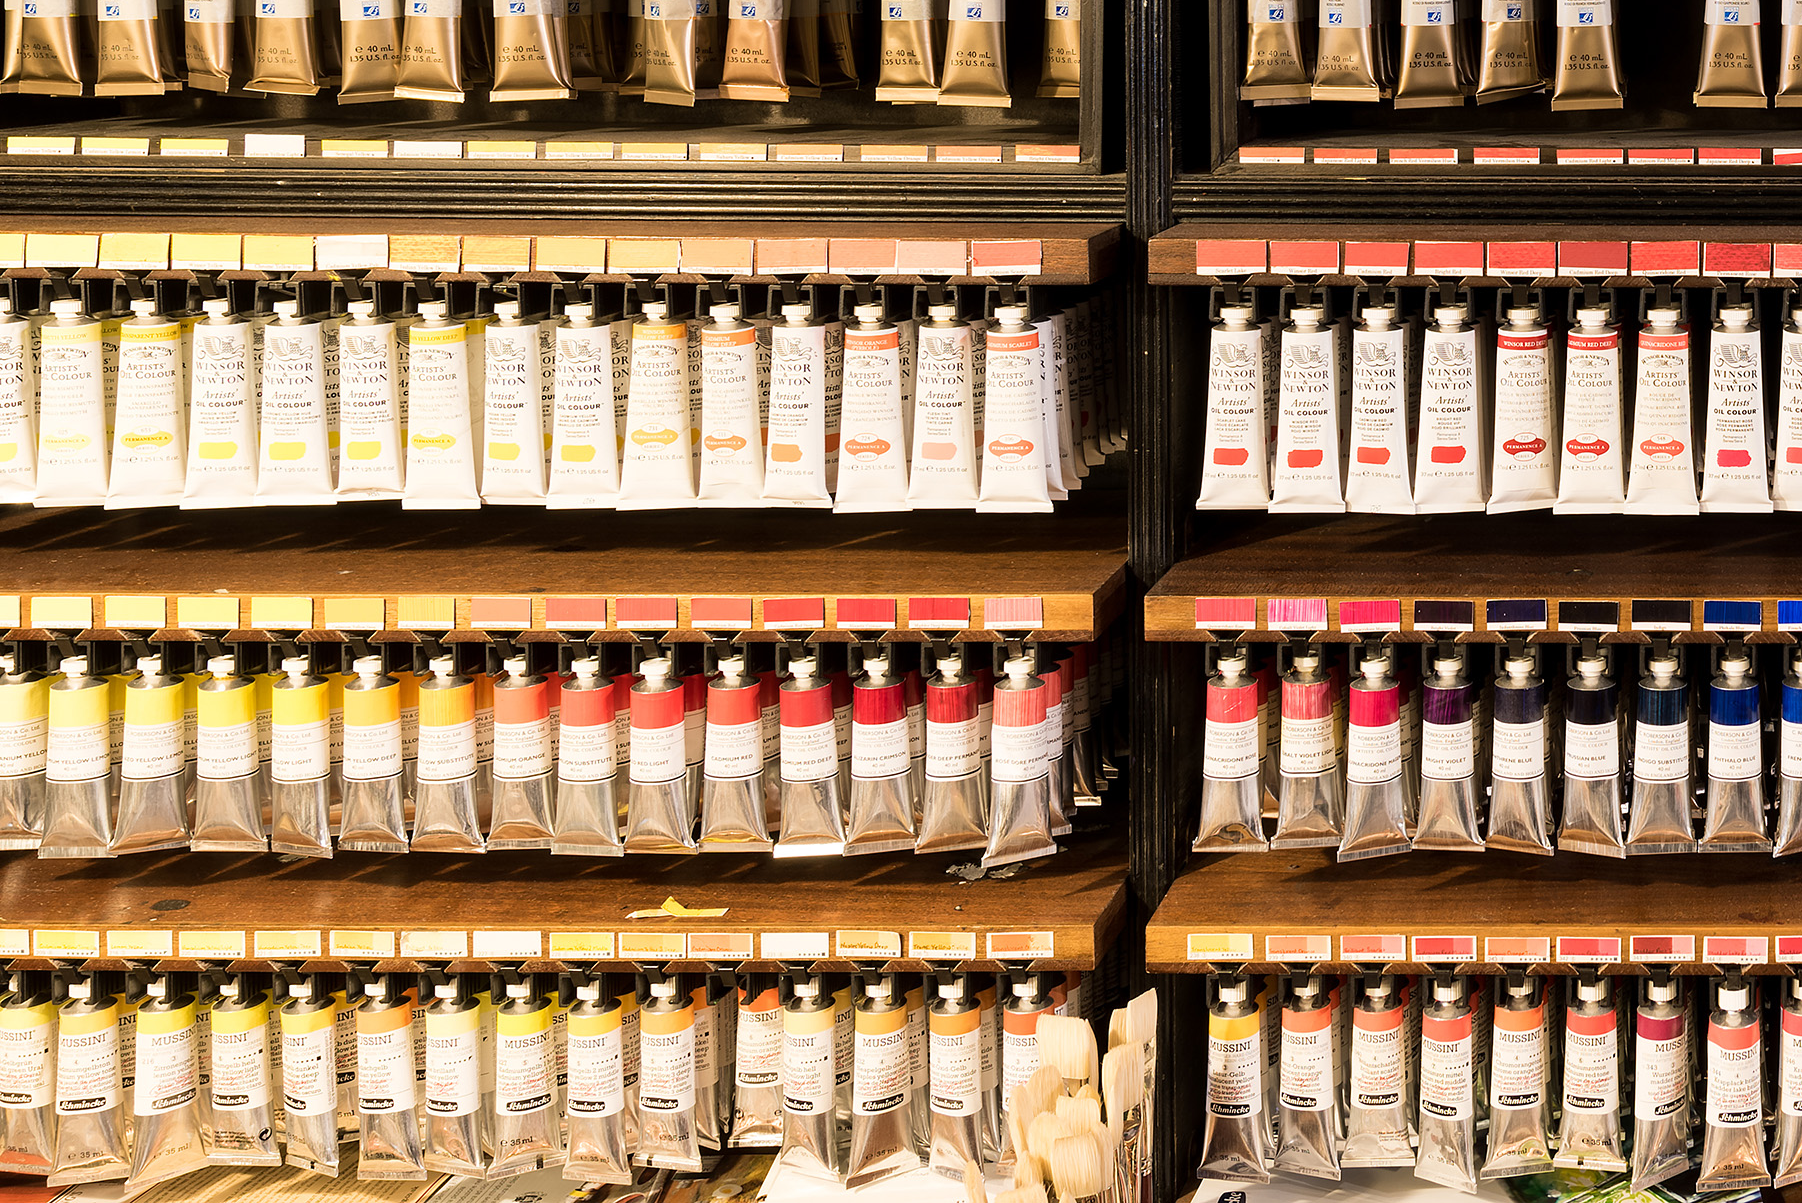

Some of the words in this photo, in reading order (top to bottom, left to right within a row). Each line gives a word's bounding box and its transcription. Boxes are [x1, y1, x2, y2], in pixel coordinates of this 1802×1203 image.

[196, 361, 244, 372] WINSOR
[1212, 368, 1256, 379] WINSOR
[196, 374, 245, 385] NEWTON
[1211, 383, 1256, 393] NEWTON
[1714, 755, 1741, 764] PHTHALO
[1742, 755, 1756, 763] BLUE
[1358, 1032, 1399, 1042] MUSSINI
[1499, 1032, 1541, 1043] MUSSINI
[56, 1097, 106, 1113] Schmincke
[1358, 1093, 1399, 1106] Schmincke
[1498, 1093, 1539, 1106] Schmincke
